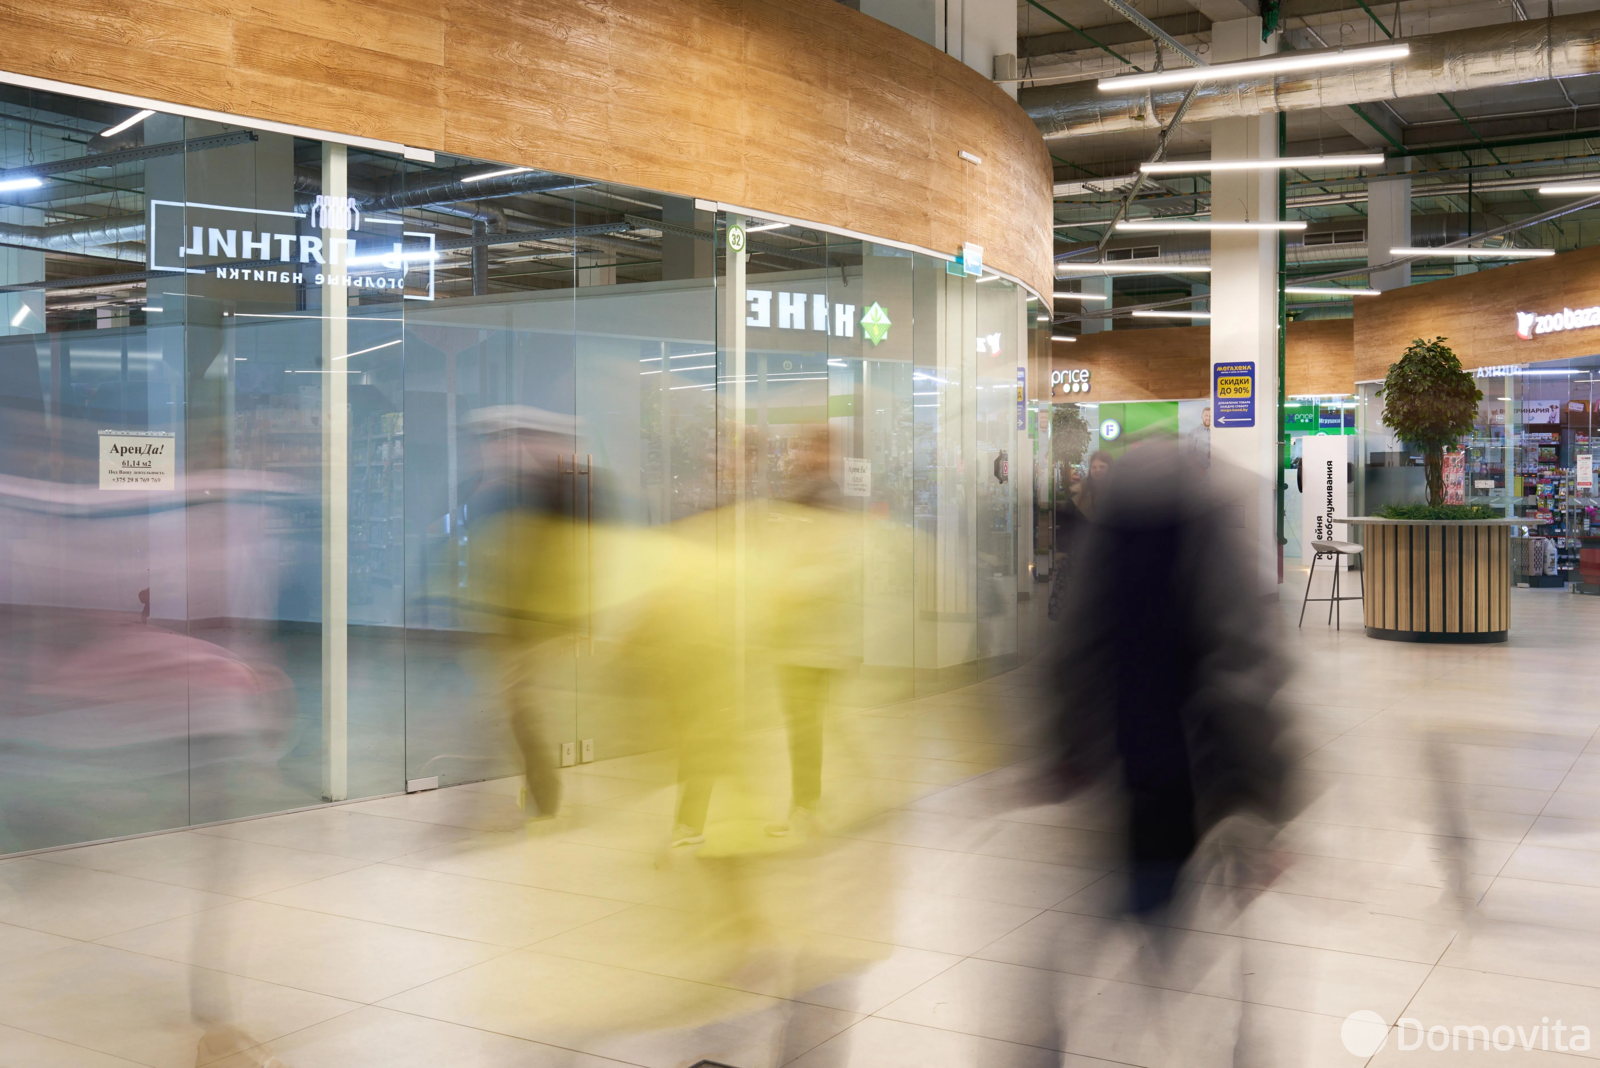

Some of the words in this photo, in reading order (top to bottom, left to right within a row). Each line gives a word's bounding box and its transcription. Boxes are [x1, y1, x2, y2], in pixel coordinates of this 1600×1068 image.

[732, 234, 740, 246] 32
[1051, 369, 1090, 388] price
[1220, 388, 1232, 396] ДО
[110, 444, 164, 456] АренДа!
